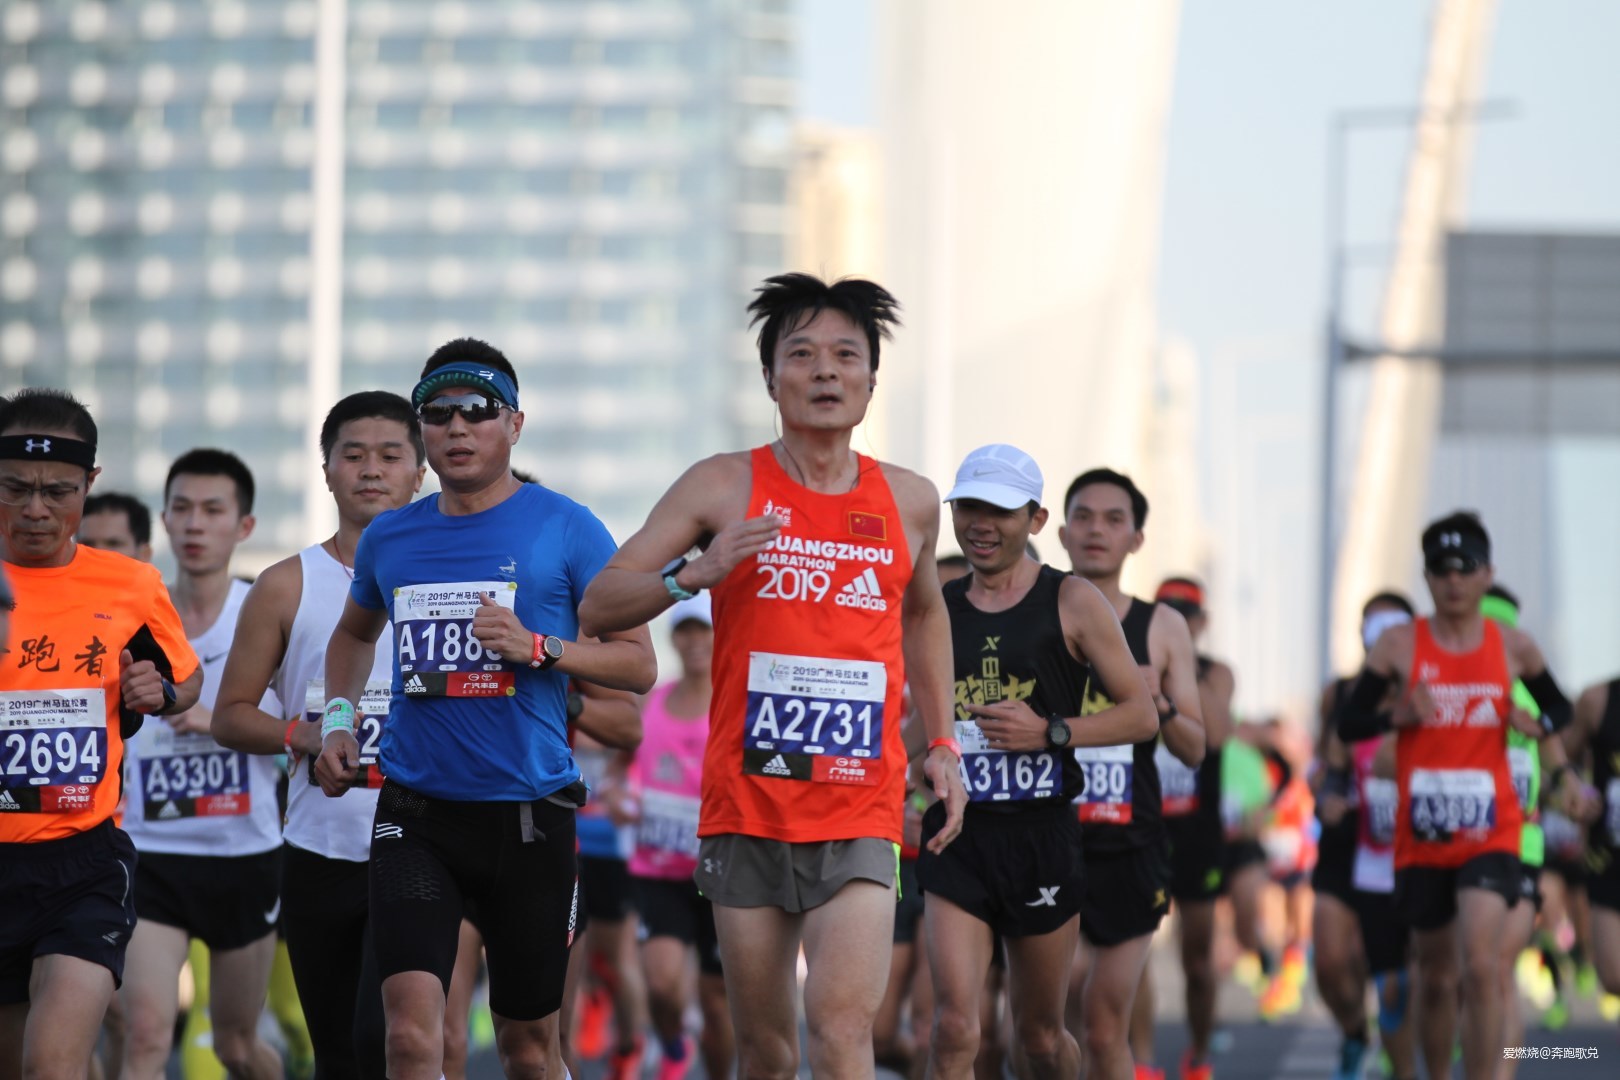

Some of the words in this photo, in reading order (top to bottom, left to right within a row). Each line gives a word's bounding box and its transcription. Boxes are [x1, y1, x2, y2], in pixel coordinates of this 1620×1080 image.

[757, 553, 836, 571] MARATHON
[757, 565, 831, 602] 2019
[428, 591, 496, 601] 2019广州马拉赛
[835, 592, 887, 611] adidas
[793, 666, 869, 680] 2019广州马拉松赛
[982, 656, 1002, 701] 中国
[9, 699, 88, 710] 2019广州马拉松赛
[751, 696, 872, 746] A2731
[0, 731, 100, 775] 2694
[146, 752, 240, 793] A3301
[762, 765, 791, 775] adidas
